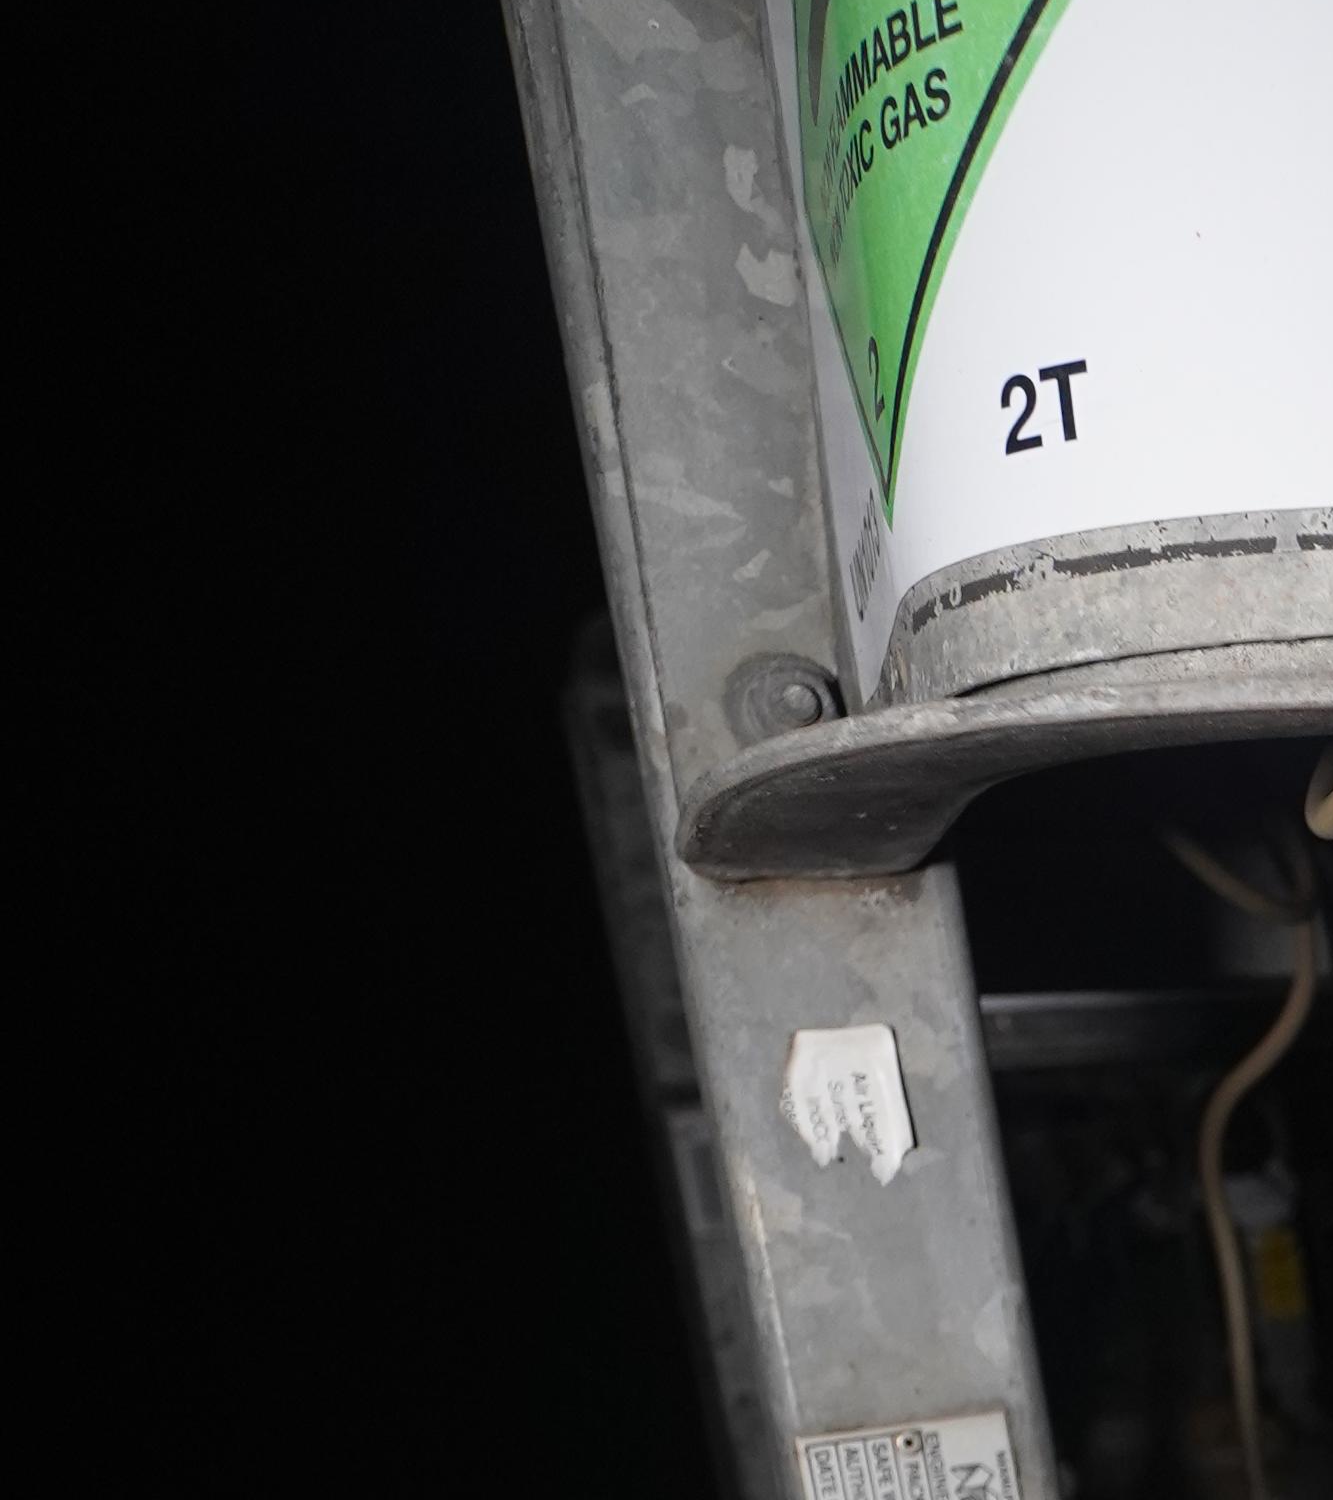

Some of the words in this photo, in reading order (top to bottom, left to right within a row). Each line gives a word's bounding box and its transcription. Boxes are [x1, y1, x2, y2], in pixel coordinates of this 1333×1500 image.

[838, 118, 876, 222] TOXIC
[878, 67, 953, 150] GAS
[867, 336, 885, 424] 2
[1001, 360, 1087, 455] 2T
[812, 1448, 838, 1497] DATE
[870, 1441, 895, 1488] SAFE
